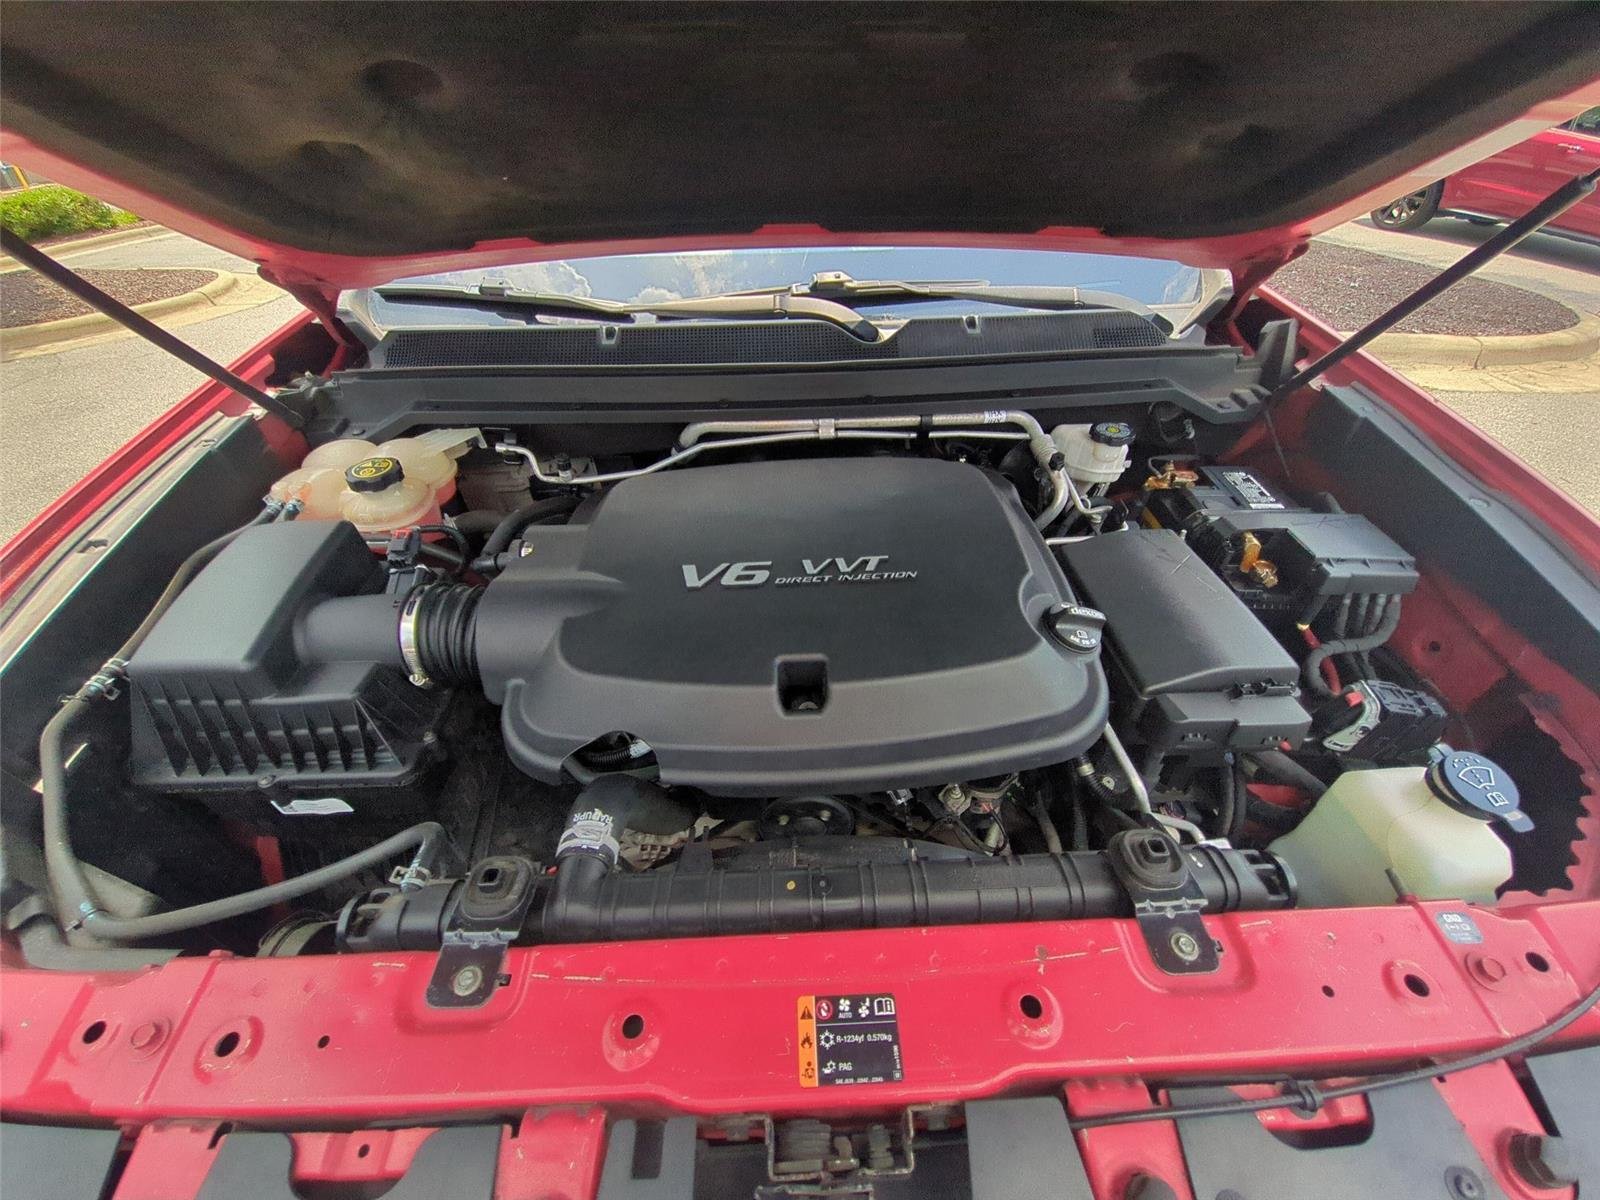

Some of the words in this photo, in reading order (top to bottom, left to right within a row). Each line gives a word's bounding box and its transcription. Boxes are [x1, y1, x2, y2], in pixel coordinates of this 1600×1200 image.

[682, 560, 773, 588] V6
[802, 555, 889, 574] VVT
[774, 575, 833, 585] DIRECT
[838, 570, 918, 582] INJECTION
[836, 1034, 864, 1043] R-1234yf
[866, 1034, 892, 1042] 0.570kg
[838, 1062, 852, 1071] PAG
